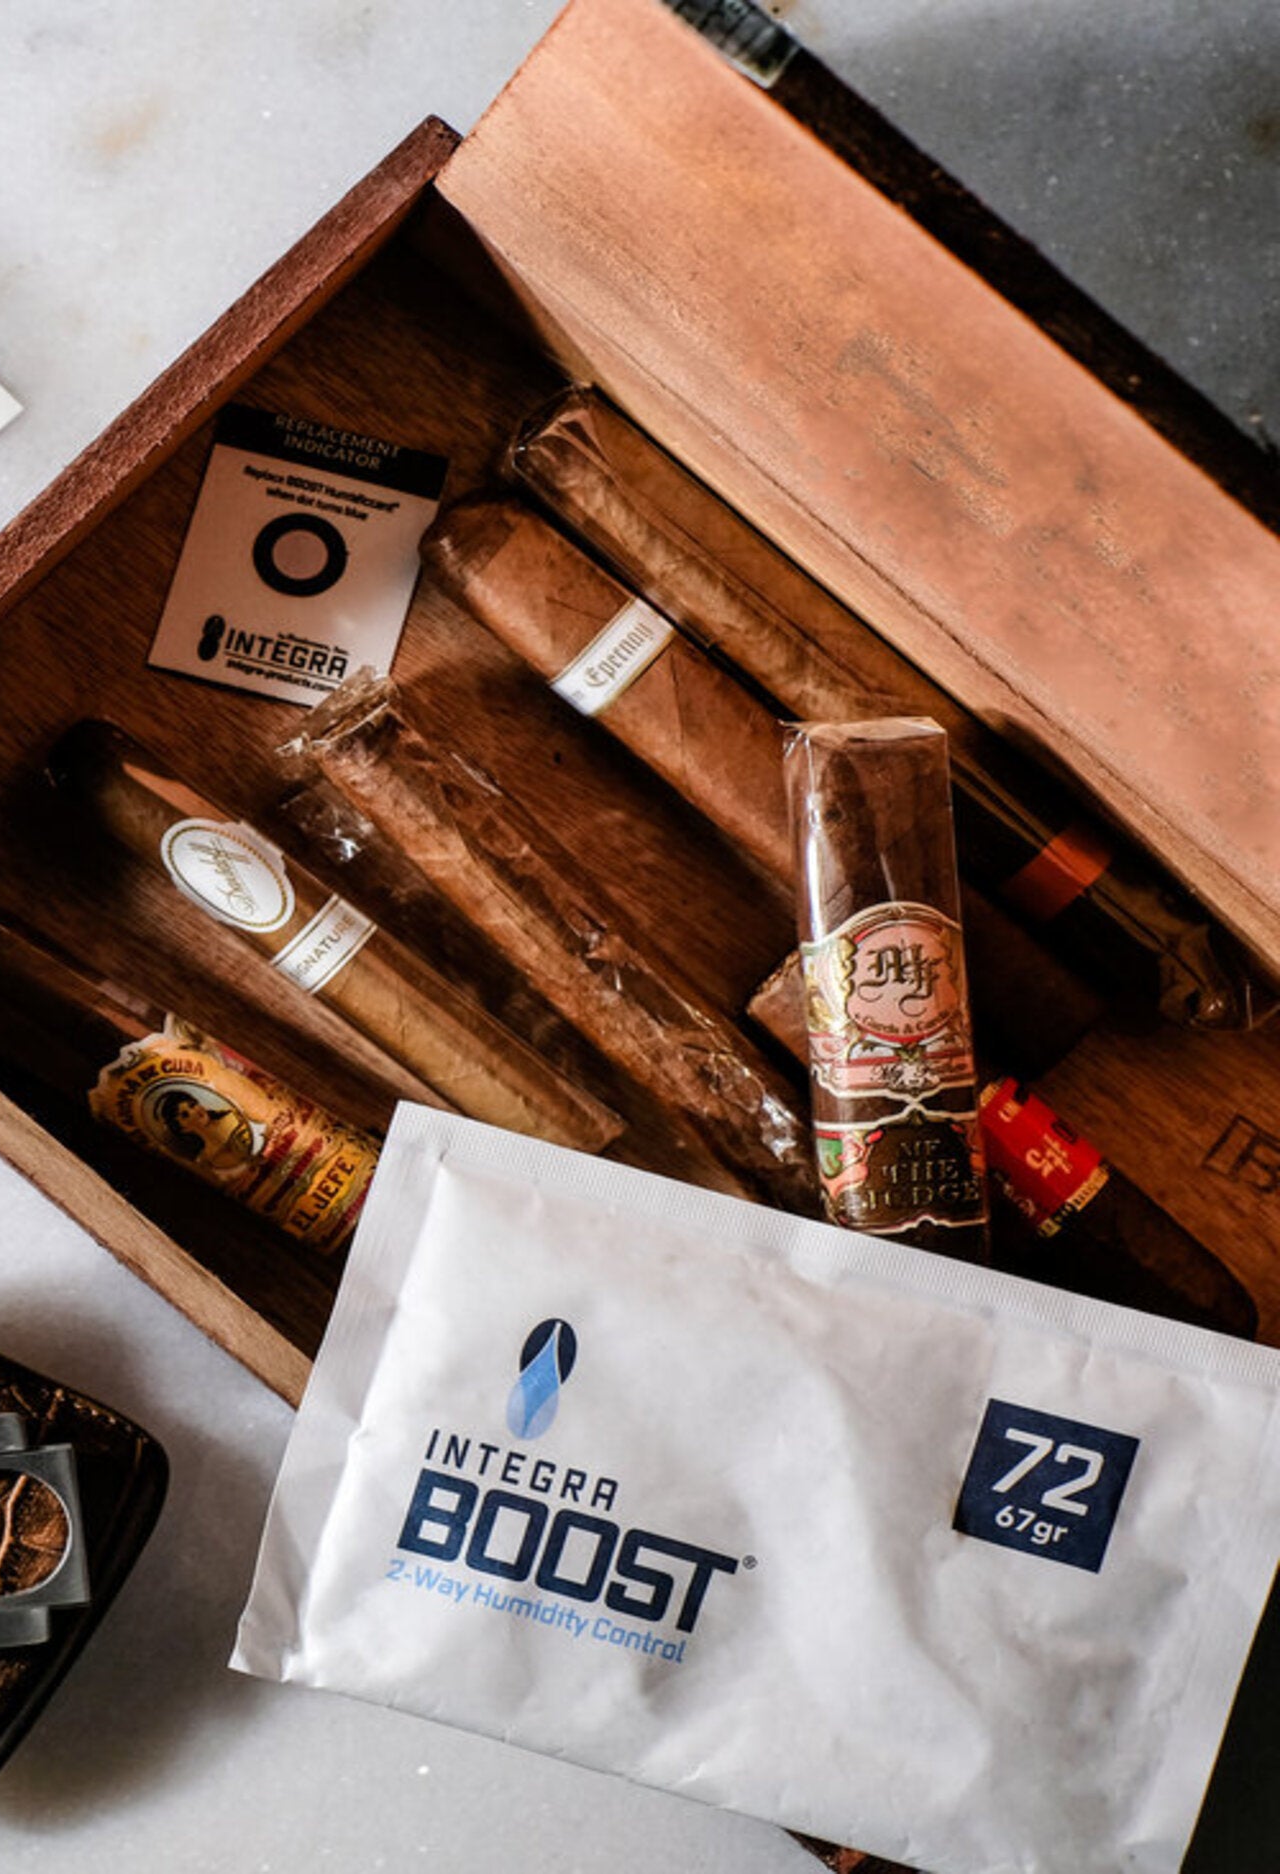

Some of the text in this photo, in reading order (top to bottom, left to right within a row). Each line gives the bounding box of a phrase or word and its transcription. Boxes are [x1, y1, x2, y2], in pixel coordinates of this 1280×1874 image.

[275, 413, 401, 459] REPLACEMENT
[284, 432, 381, 470] INDICATOR
[344, 506, 369, 521] blue
[224, 628, 350, 680] INTEGRA
[161, 1057, 205, 1077] CUBA
[292, 1155, 356, 1233] EL JEFE
[425, 1428, 619, 1511] INTEGRA
[990, 1427, 1107, 1518] 72
[396, 1467, 740, 1634] BOOST
[994, 1504, 1070, 1547] 67gr
[384, 1558, 689, 1665] 2-Way Humidity Control
